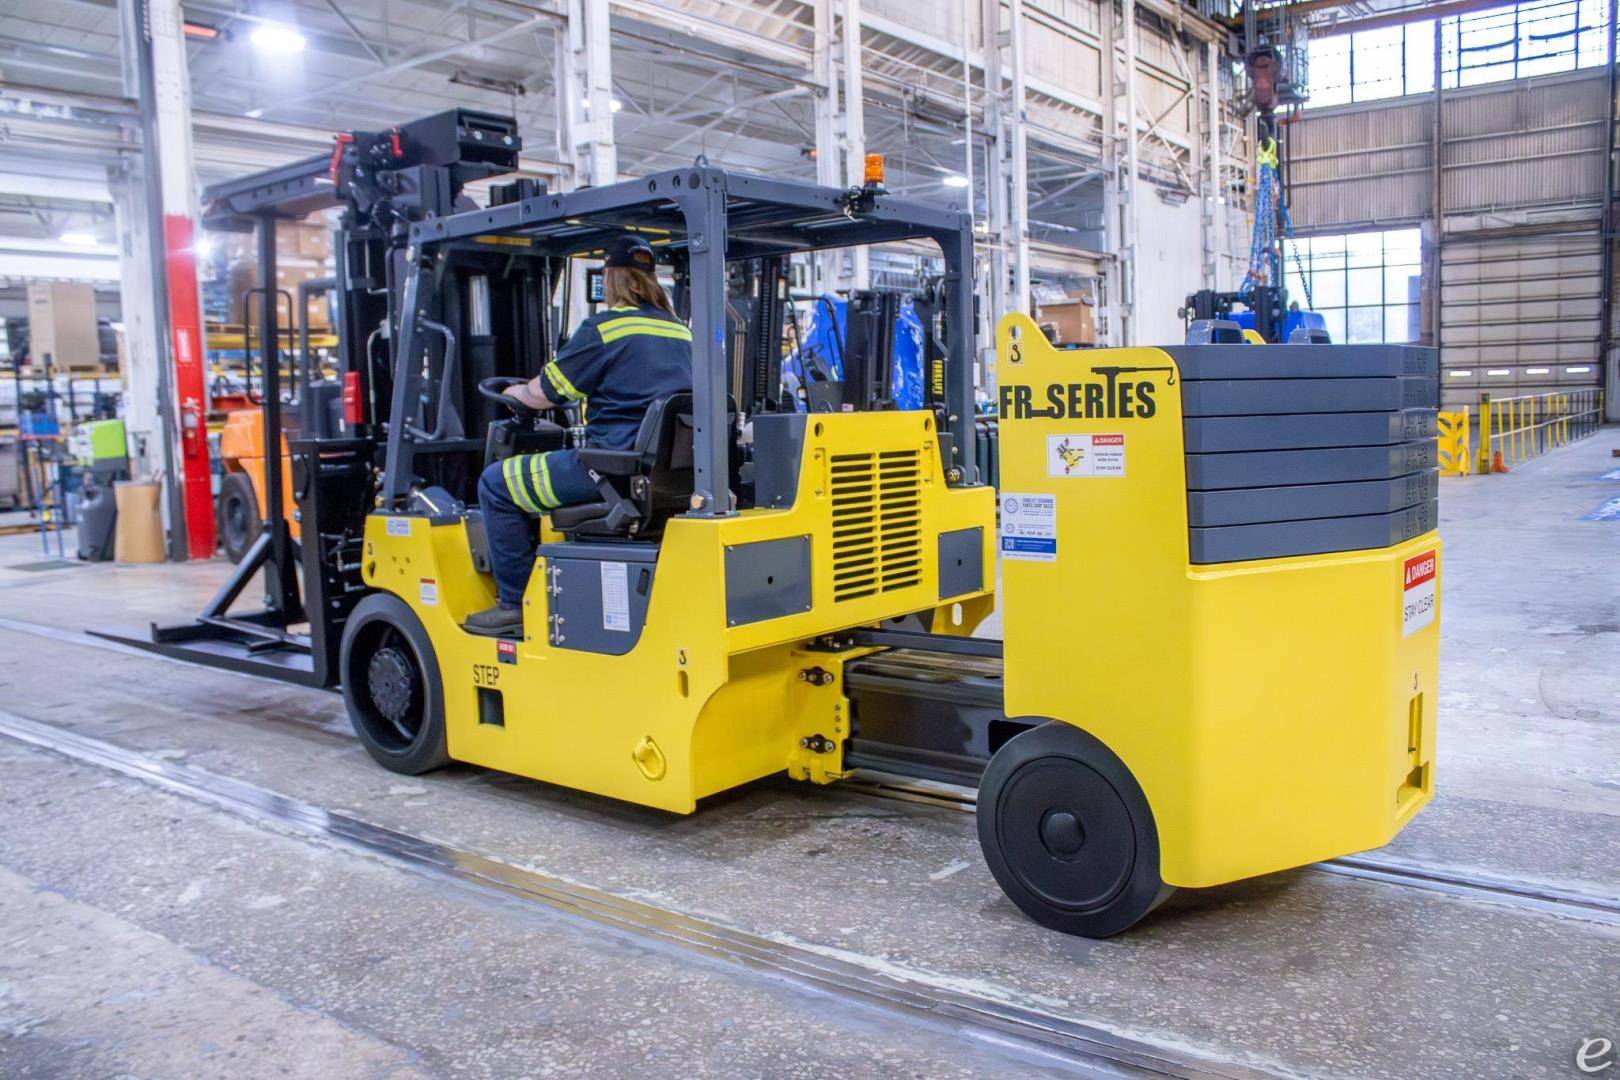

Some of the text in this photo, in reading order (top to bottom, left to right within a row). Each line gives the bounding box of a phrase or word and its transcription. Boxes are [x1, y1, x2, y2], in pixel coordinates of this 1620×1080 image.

[999, 367, 1156, 419] FR SERIES
[1411, 558, 1434, 580] DANGER
[1405, 594, 1434, 621] STAY CLEAR
[473, 664, 500, 685] STEP
